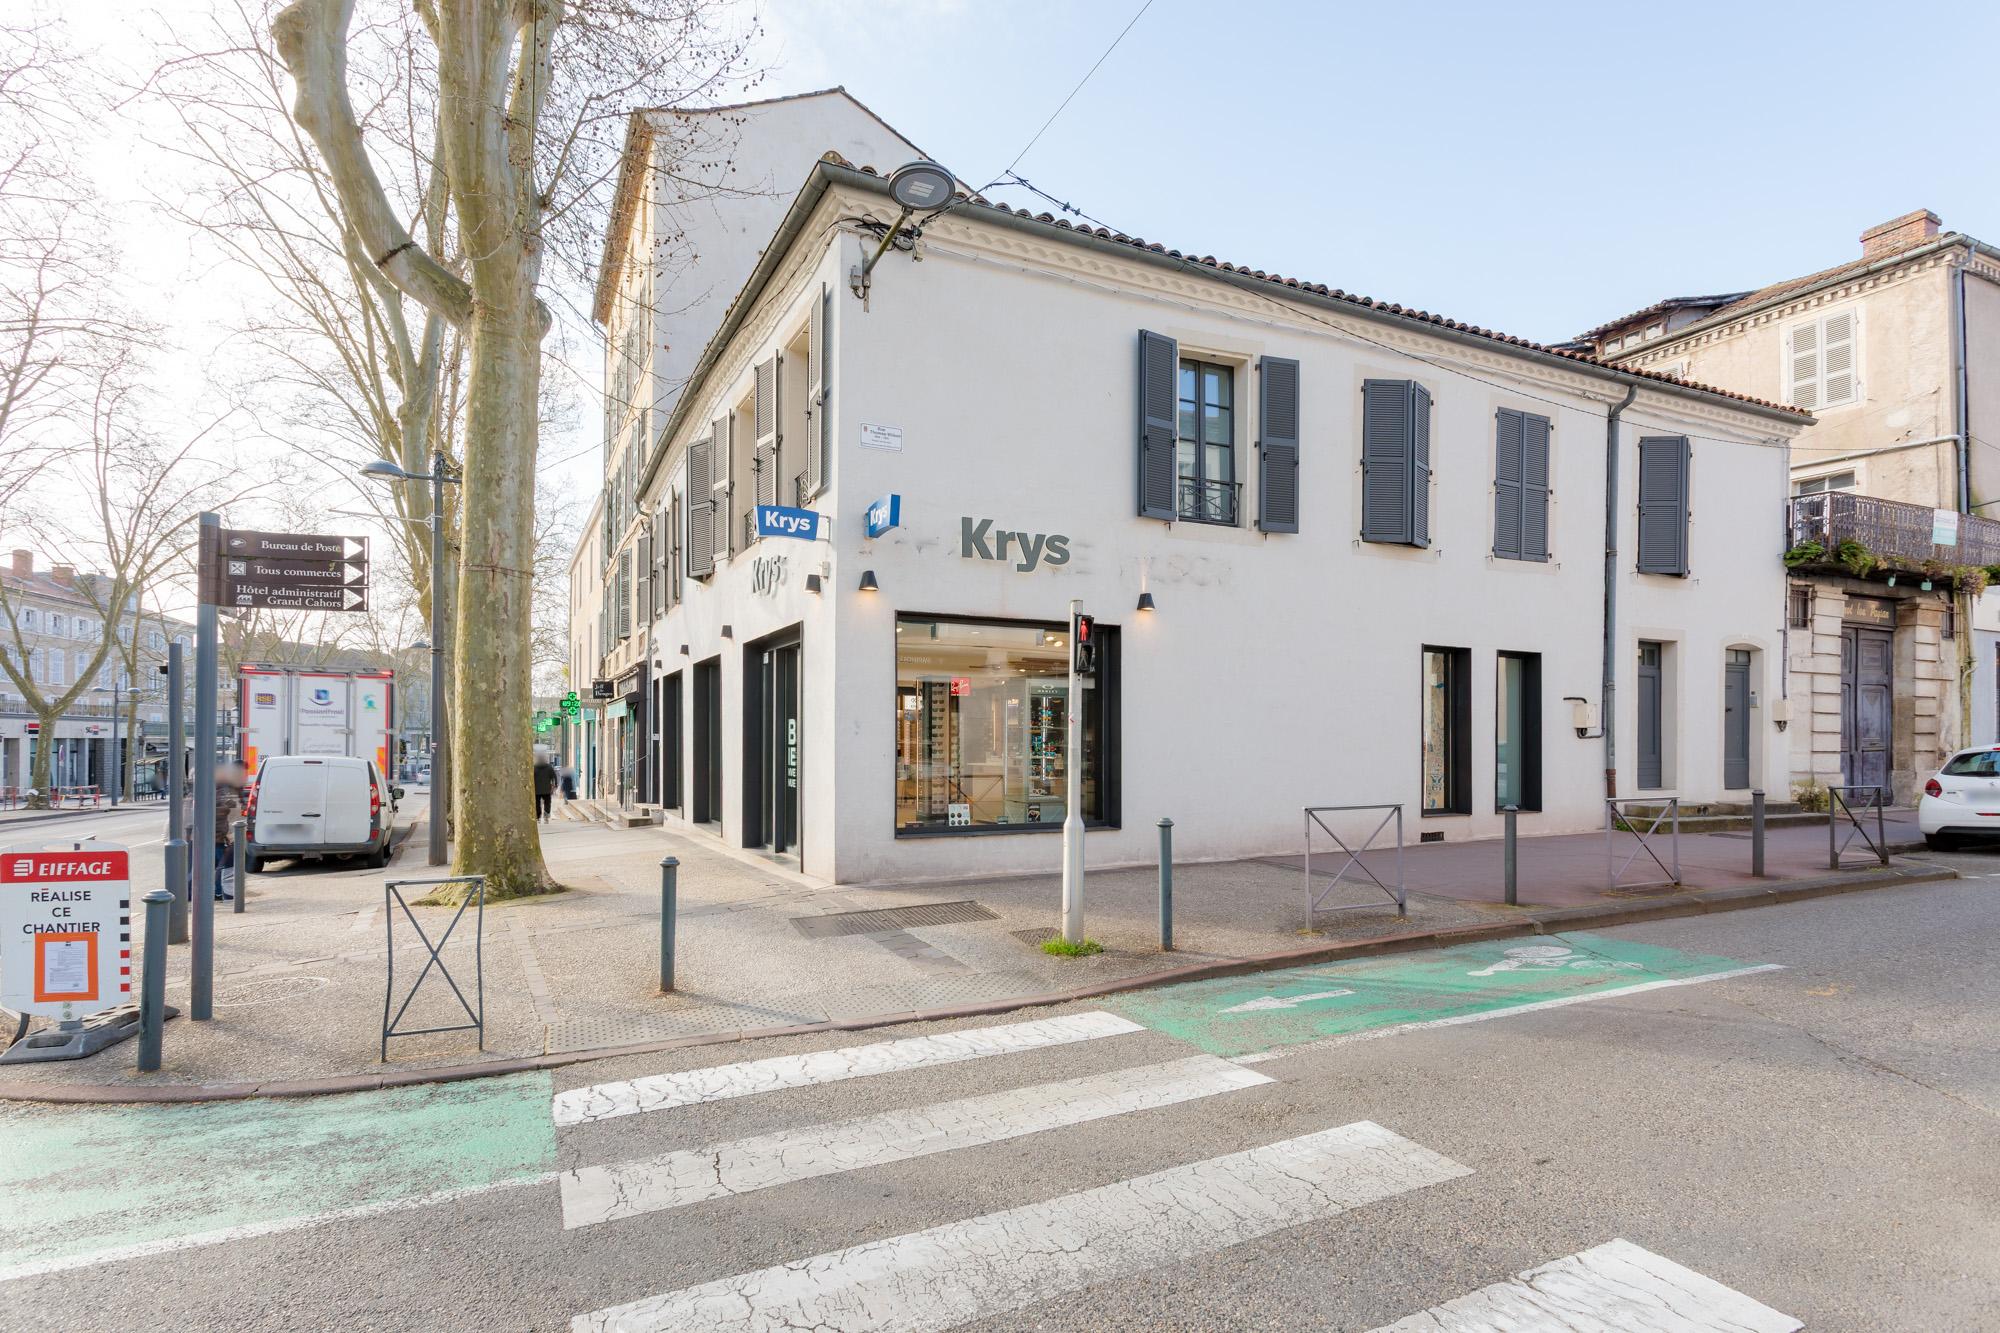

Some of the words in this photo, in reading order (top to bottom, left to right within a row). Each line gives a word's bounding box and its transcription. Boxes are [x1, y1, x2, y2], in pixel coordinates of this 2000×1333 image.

[765, 510, 811, 532] Krys
[870, 504, 888, 526] Krys
[261, 540, 299, 551] Bureau
[300, 543, 313, 551] de
[315, 543, 341, 553] Poste
[961, 516, 1071, 573] Krys
[254, 565, 281, 576] Tous
[283, 567, 342, 578] commerces
[236, 584, 268, 595] Hôtel
[272, 587, 342, 598] administratif
[267, 596, 302, 607] Grand
[305, 598, 342, 608] Cahors
[39, 861, 112, 876] EIFFAGE
[52, 907, 71, 917] CE
[23, 921, 101, 935] CHANTIER
